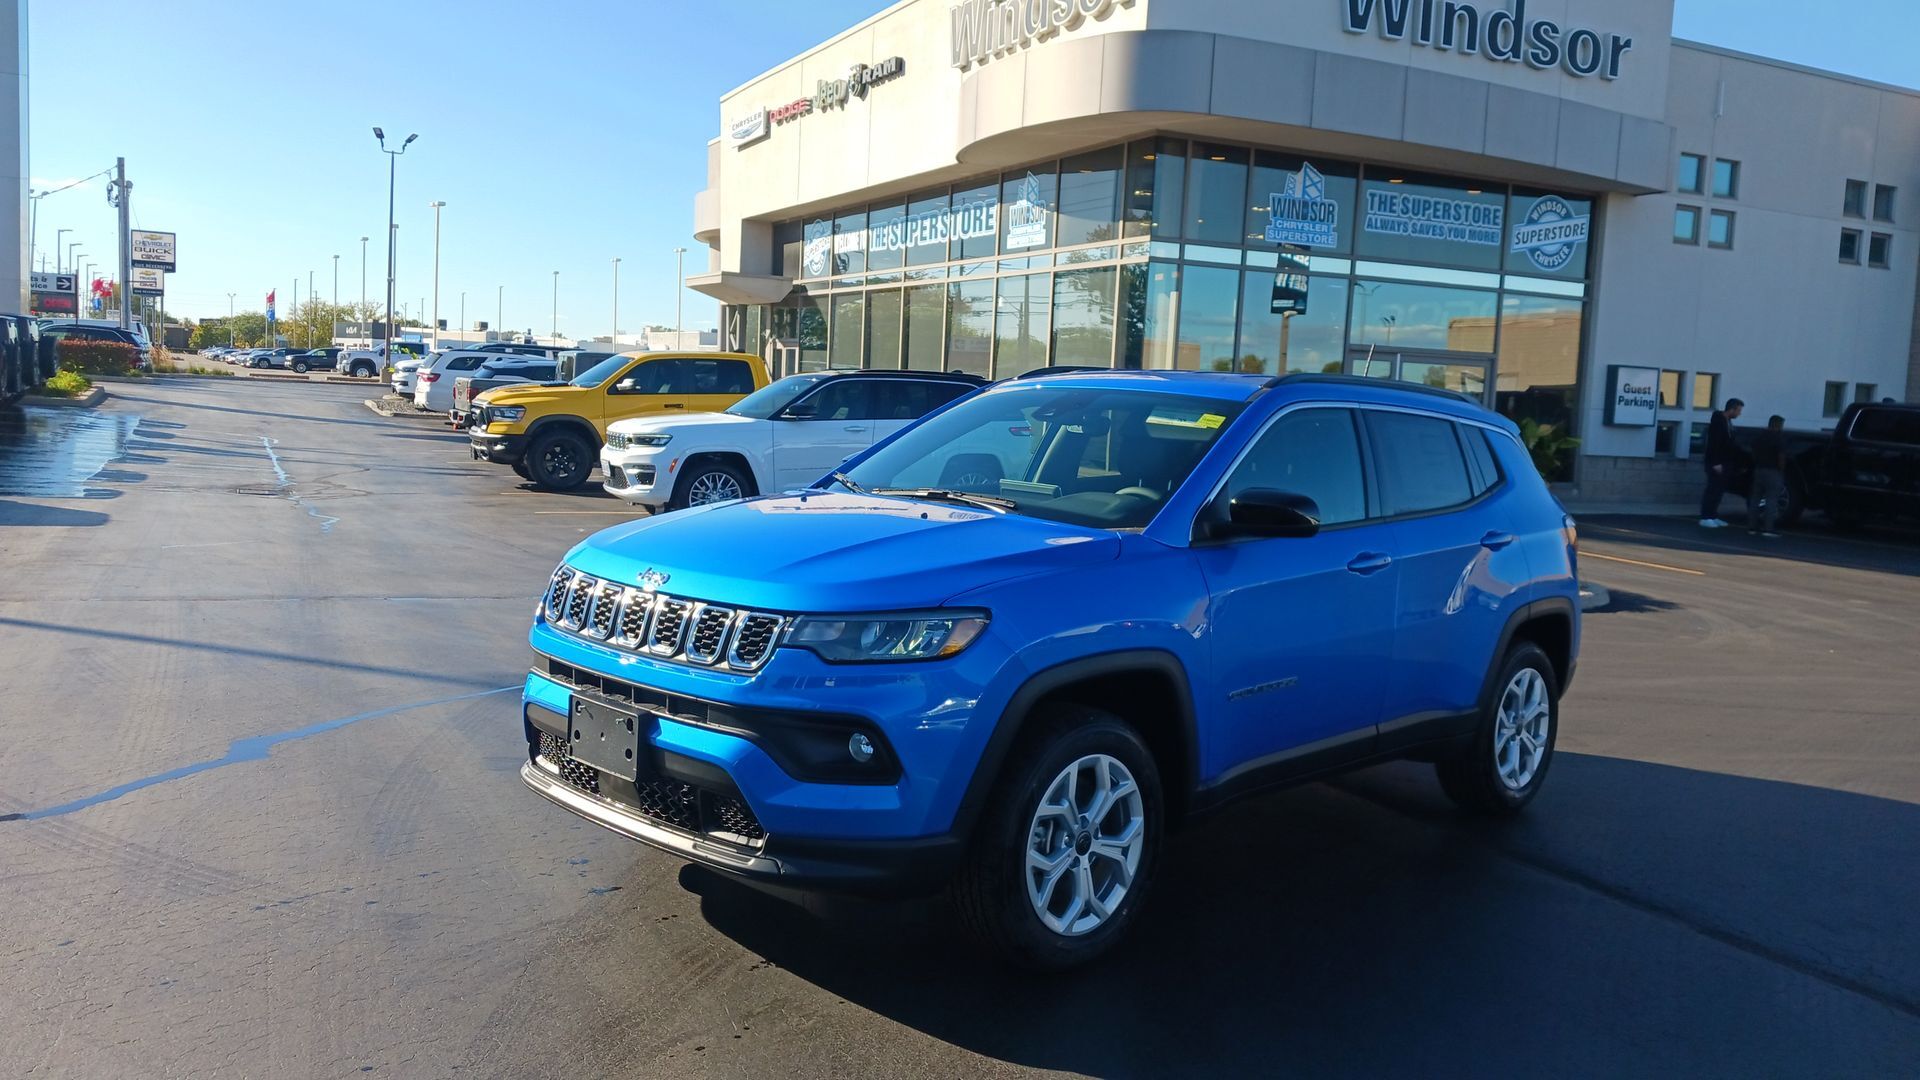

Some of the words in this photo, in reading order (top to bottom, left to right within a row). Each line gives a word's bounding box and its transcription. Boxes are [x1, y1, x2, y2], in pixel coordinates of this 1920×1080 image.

[950, 0, 1121, 69] Winds
[862, 56, 900, 84] RAM
[813, 79, 847, 109] Jeep
[732, 111, 762, 131] CHRYSLER
[769, 97, 809, 123] DODGE
[1272, 196, 1335, 223] WINDSOR
[1368, 192, 1397, 214] THE
[1401, 196, 1500, 226] SUPERSTORE
[1531, 201, 1567, 220] WINDSOR
[870, 224, 887, 250] THE
[889, 202, 995, 250] SUPERSTORE
[1268, 229, 1334, 245] SUPERSTORE
[1277, 219, 1328, 232] CHRYSLER
[1366, 217, 1409, 233] ALWAYS
[1411, 221, 1445, 237] SAVES
[1447, 226, 1466, 240] YOU
[1468, 229, 1499, 244] MORE!
[1515, 222, 1586, 245] SUPERSTORE
[1534, 245, 1570, 267] CHRYSLER
[1623, 383, 1651, 395] Guest
[1617, 396, 1655, 409] Parking
